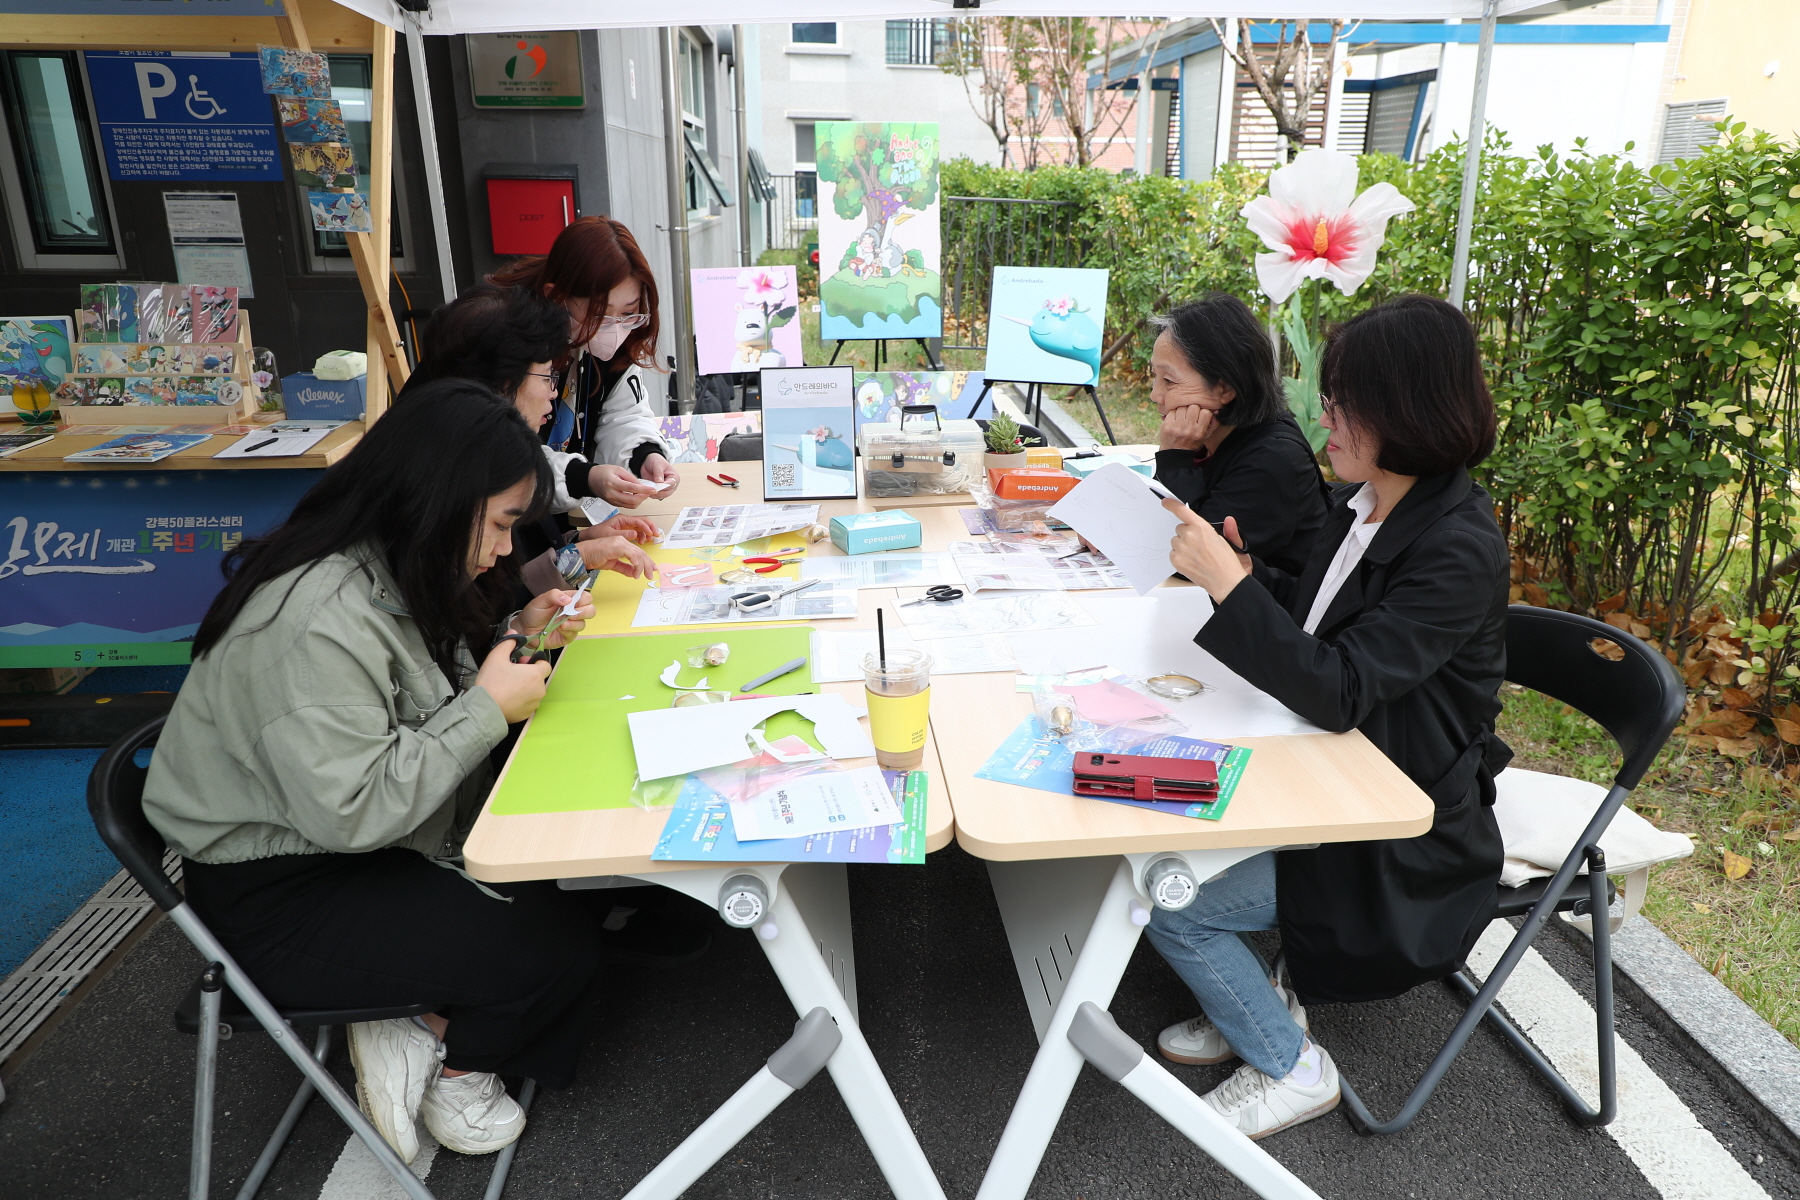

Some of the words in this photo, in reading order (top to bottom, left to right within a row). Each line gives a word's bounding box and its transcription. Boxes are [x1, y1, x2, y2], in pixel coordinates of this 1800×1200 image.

[134, 62, 176, 119] P
[890, 133, 919, 150] Andre
[894, 150, 914, 162] and
[890, 169, 921, 185] Ocean
[794, 382, 838, 392] 안드레의바다
[297, 388, 345, 405] Kleenex
[146, 516, 243, 528] 강북50플러스센터
[106, 538, 136, 552] 개관
[137, 530, 195, 553] 1주년
[200, 530, 243, 552] 기념
[863, 534, 906, 544] Andrebada
[452, 1094, 469, 1108] FILA
